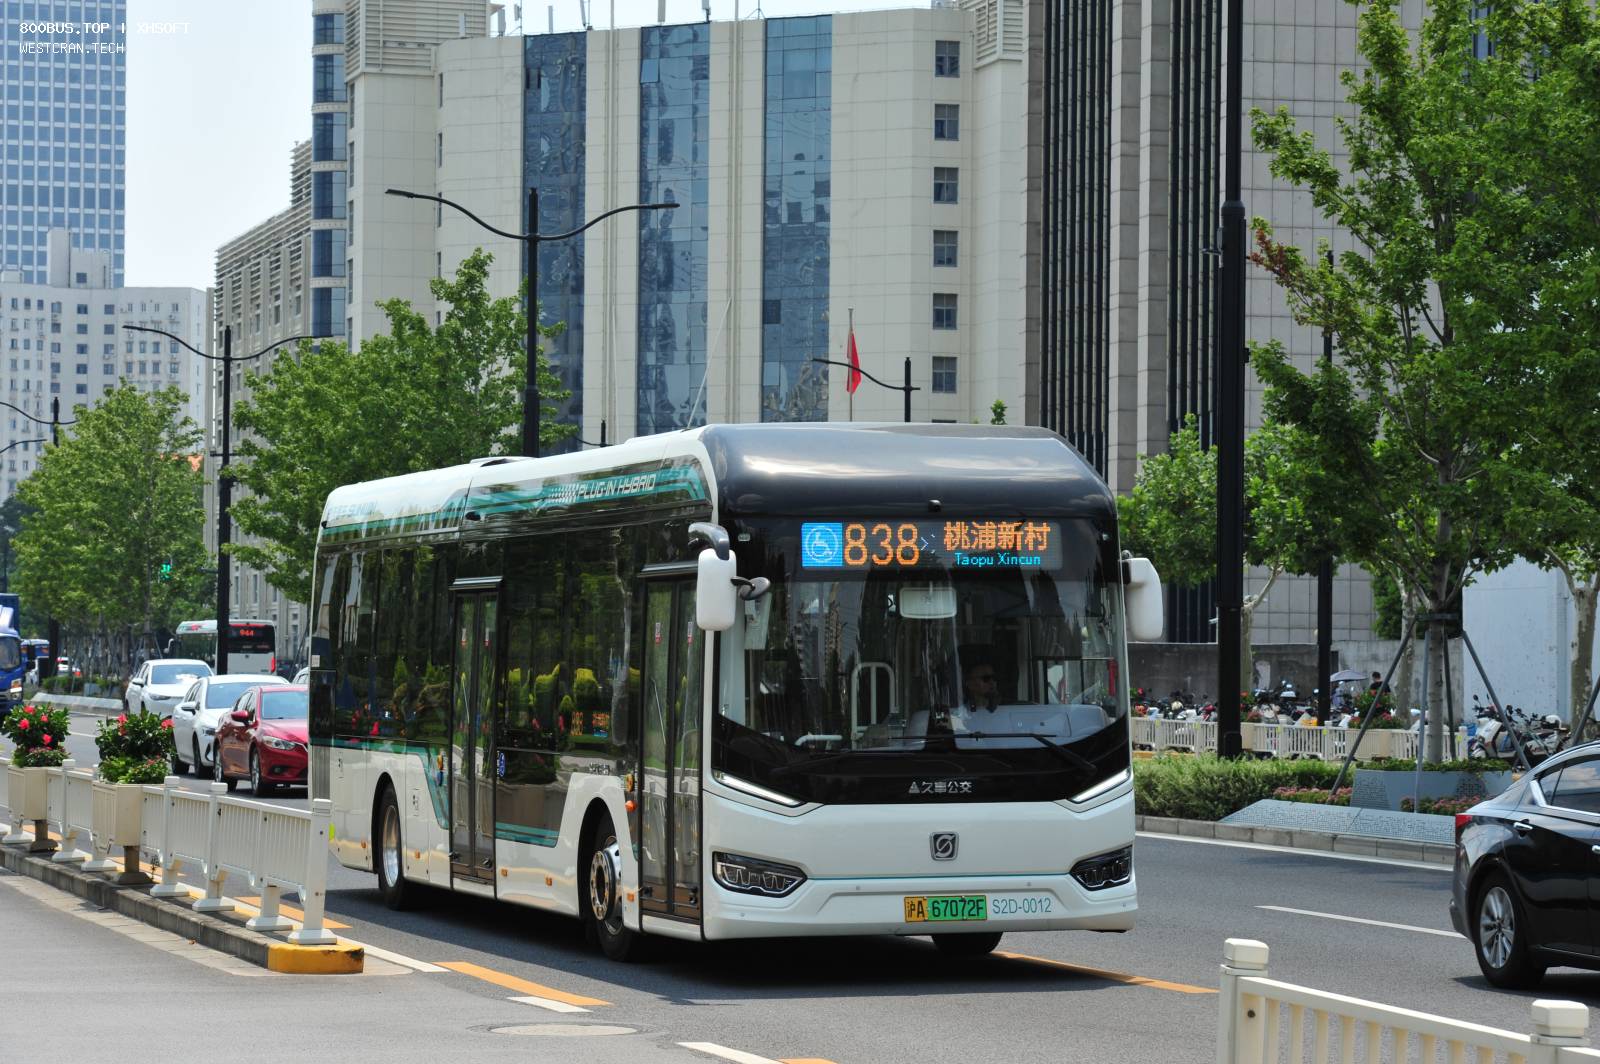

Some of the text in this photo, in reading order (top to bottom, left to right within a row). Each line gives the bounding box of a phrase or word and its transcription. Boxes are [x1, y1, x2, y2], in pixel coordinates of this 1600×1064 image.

[618, 474, 656, 493] HYBRID
[844, 523, 920, 566] 838
[943, 521, 1052, 551] 桃浦新村
[955, 552, 1042, 568] Taopu Xincun
[992, 897, 1052, 915] S2D-0012
